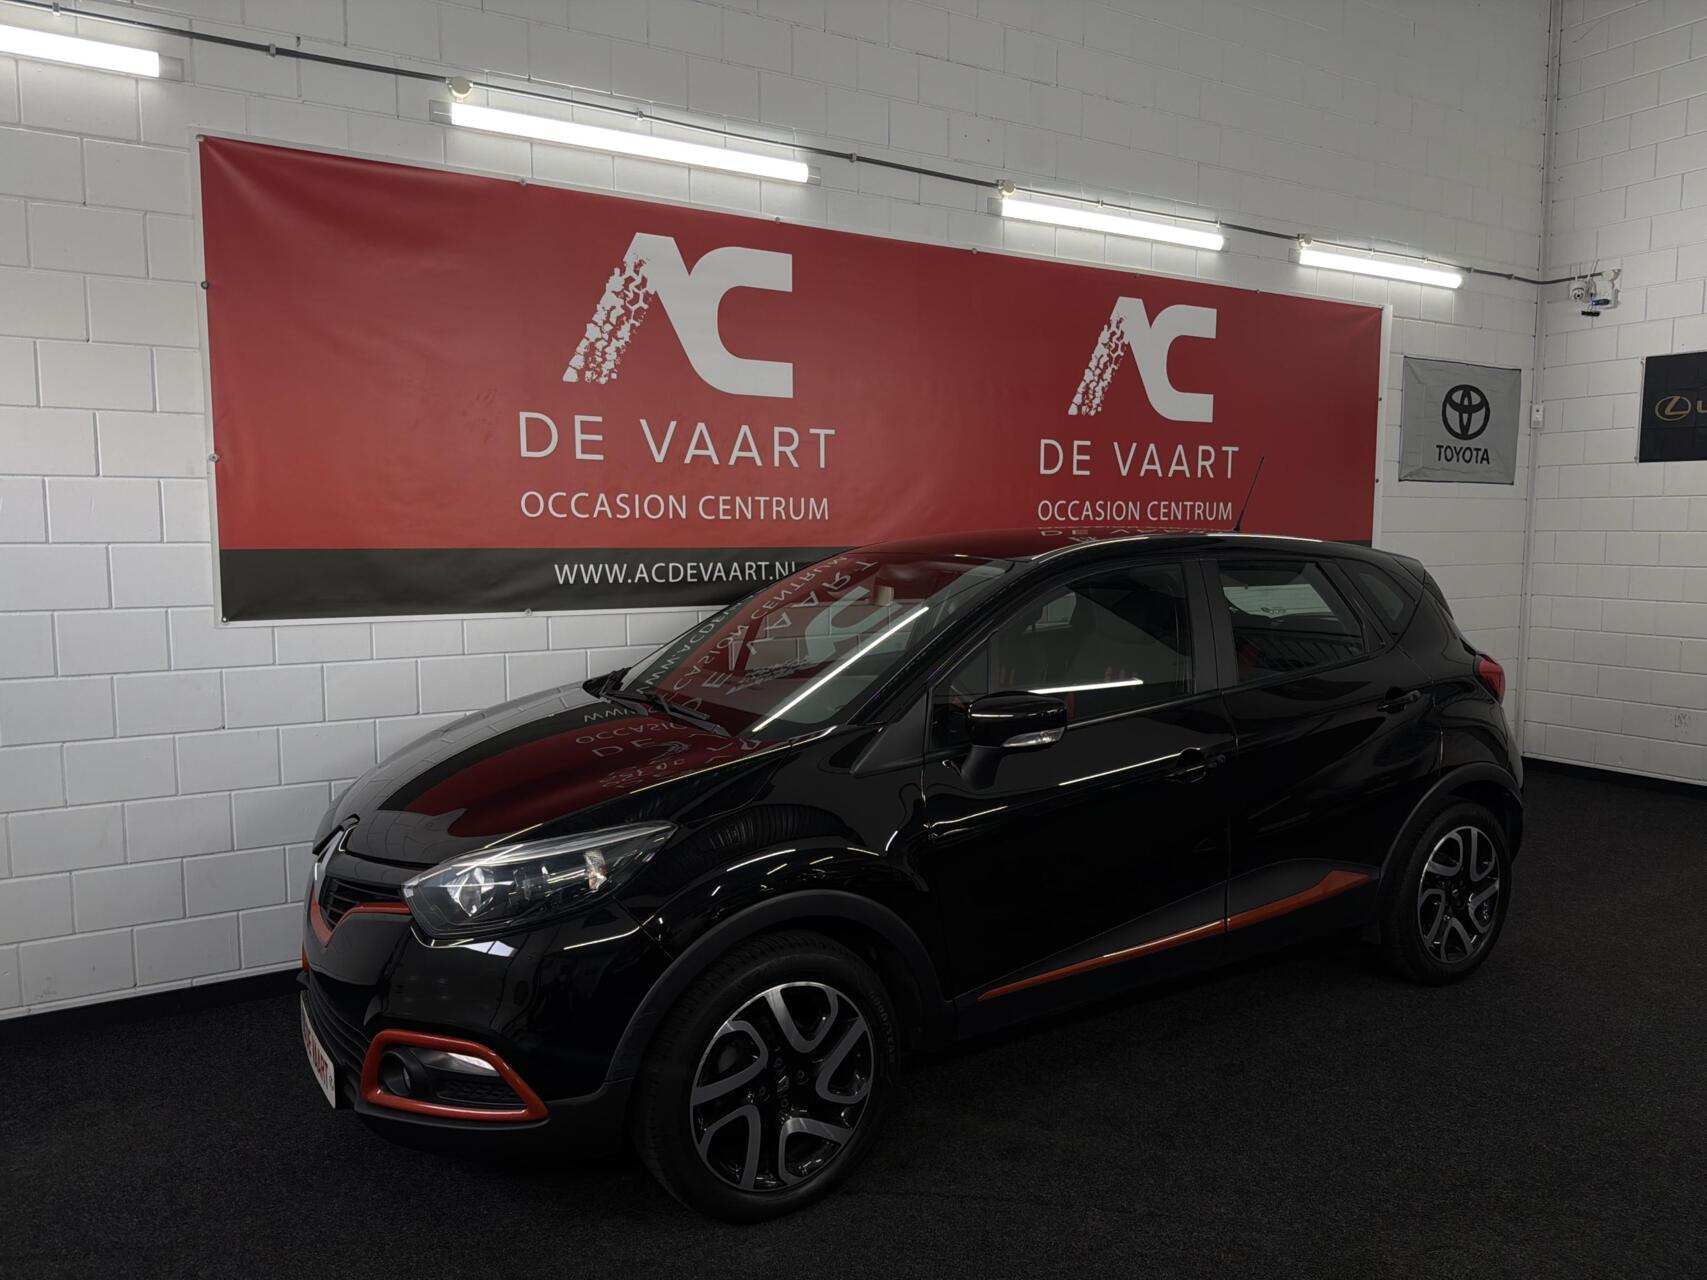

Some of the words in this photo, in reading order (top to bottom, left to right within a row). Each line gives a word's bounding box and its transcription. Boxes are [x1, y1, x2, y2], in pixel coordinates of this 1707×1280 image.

[562, 232, 793, 399] AC
[1068, 296, 1217, 423] AC
[518, 411, 605, 461] DE
[639, 418, 836, 469] VAART
[1039, 438, 1092, 476] DE
[1113, 441, 1240, 480] VAART
[1435, 444, 1490, 465] TOYOTA
[520, 491, 687, 520] OCCASION
[698, 495, 830, 521] CENTRUM
[1037, 500, 1141, 521] OCCASION
[1147, 501, 1233, 521] CENTRUM
